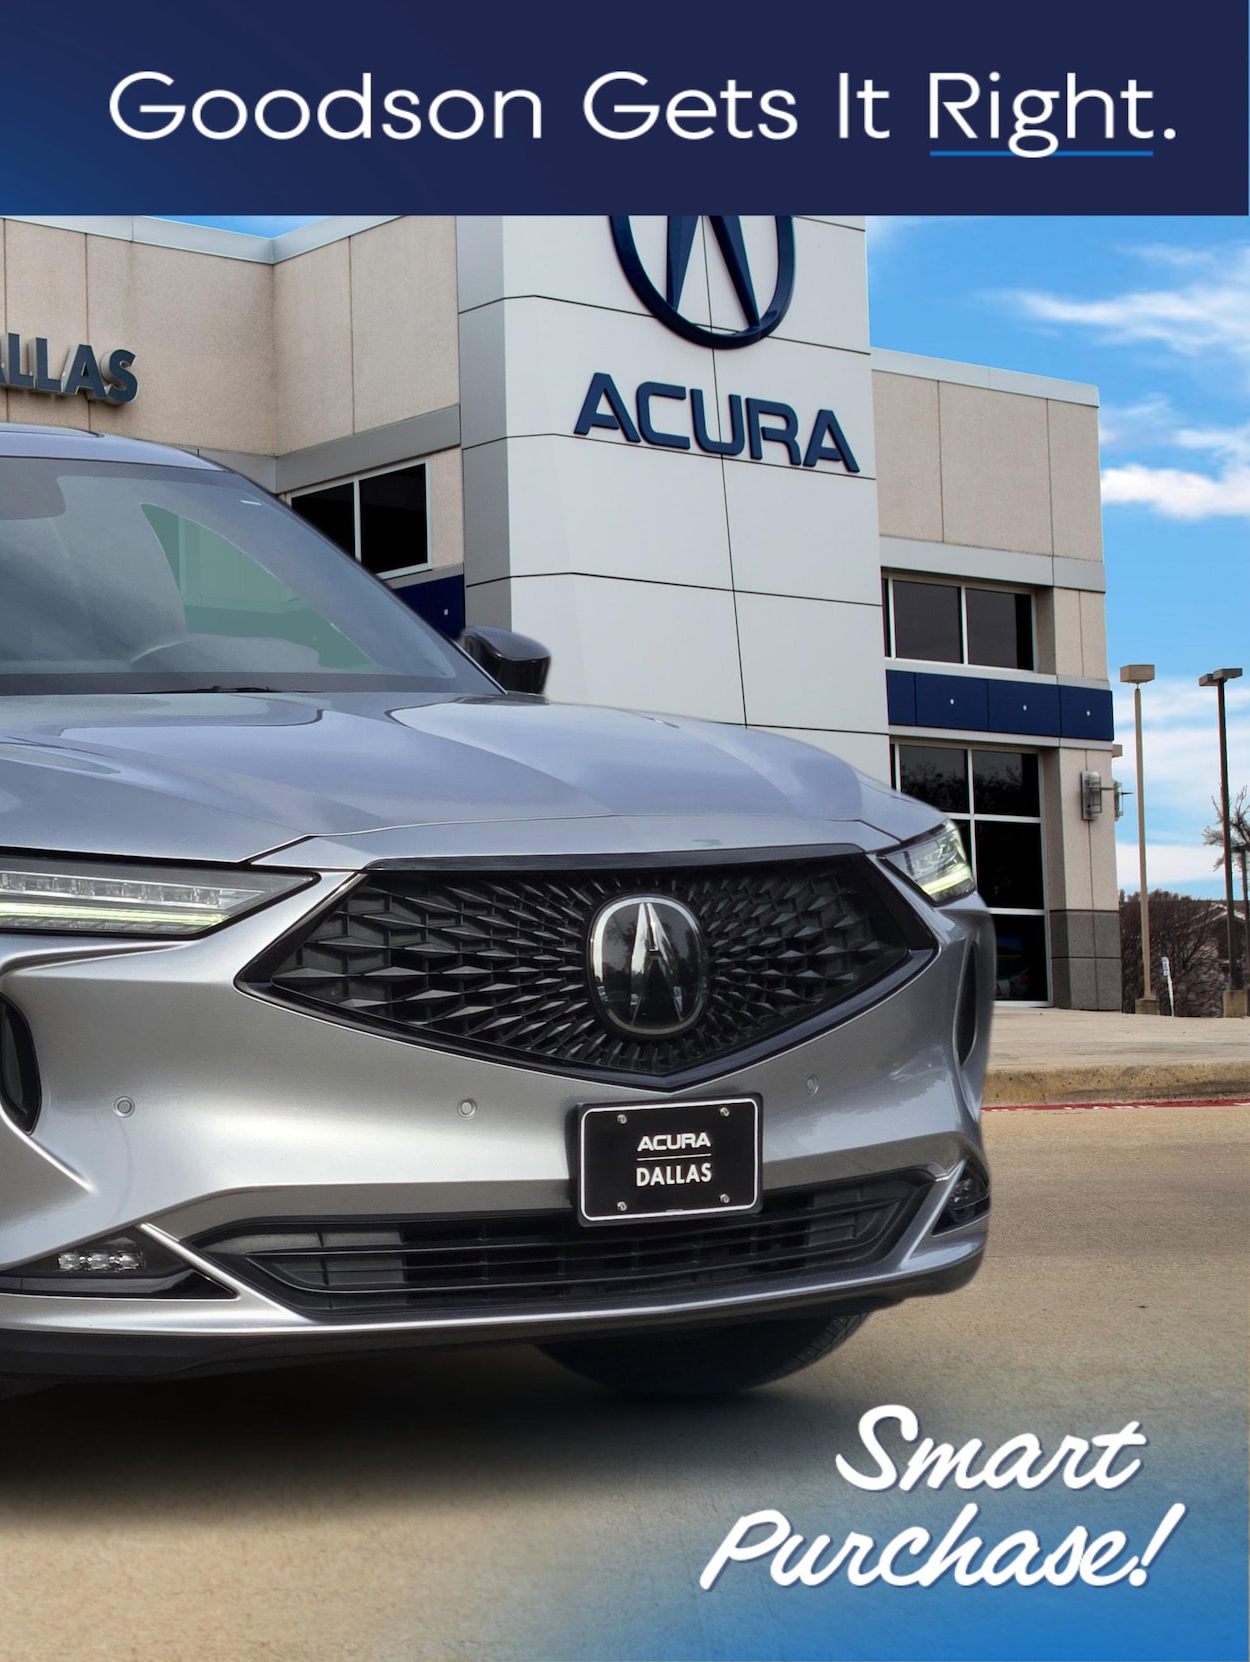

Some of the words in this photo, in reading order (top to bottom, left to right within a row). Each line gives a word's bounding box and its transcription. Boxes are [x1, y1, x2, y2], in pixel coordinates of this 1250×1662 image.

[573, 372, 861, 474] ACURA
[636, 1132, 712, 1152] ACURA
[636, 1162, 712, 1188] DALLAS
